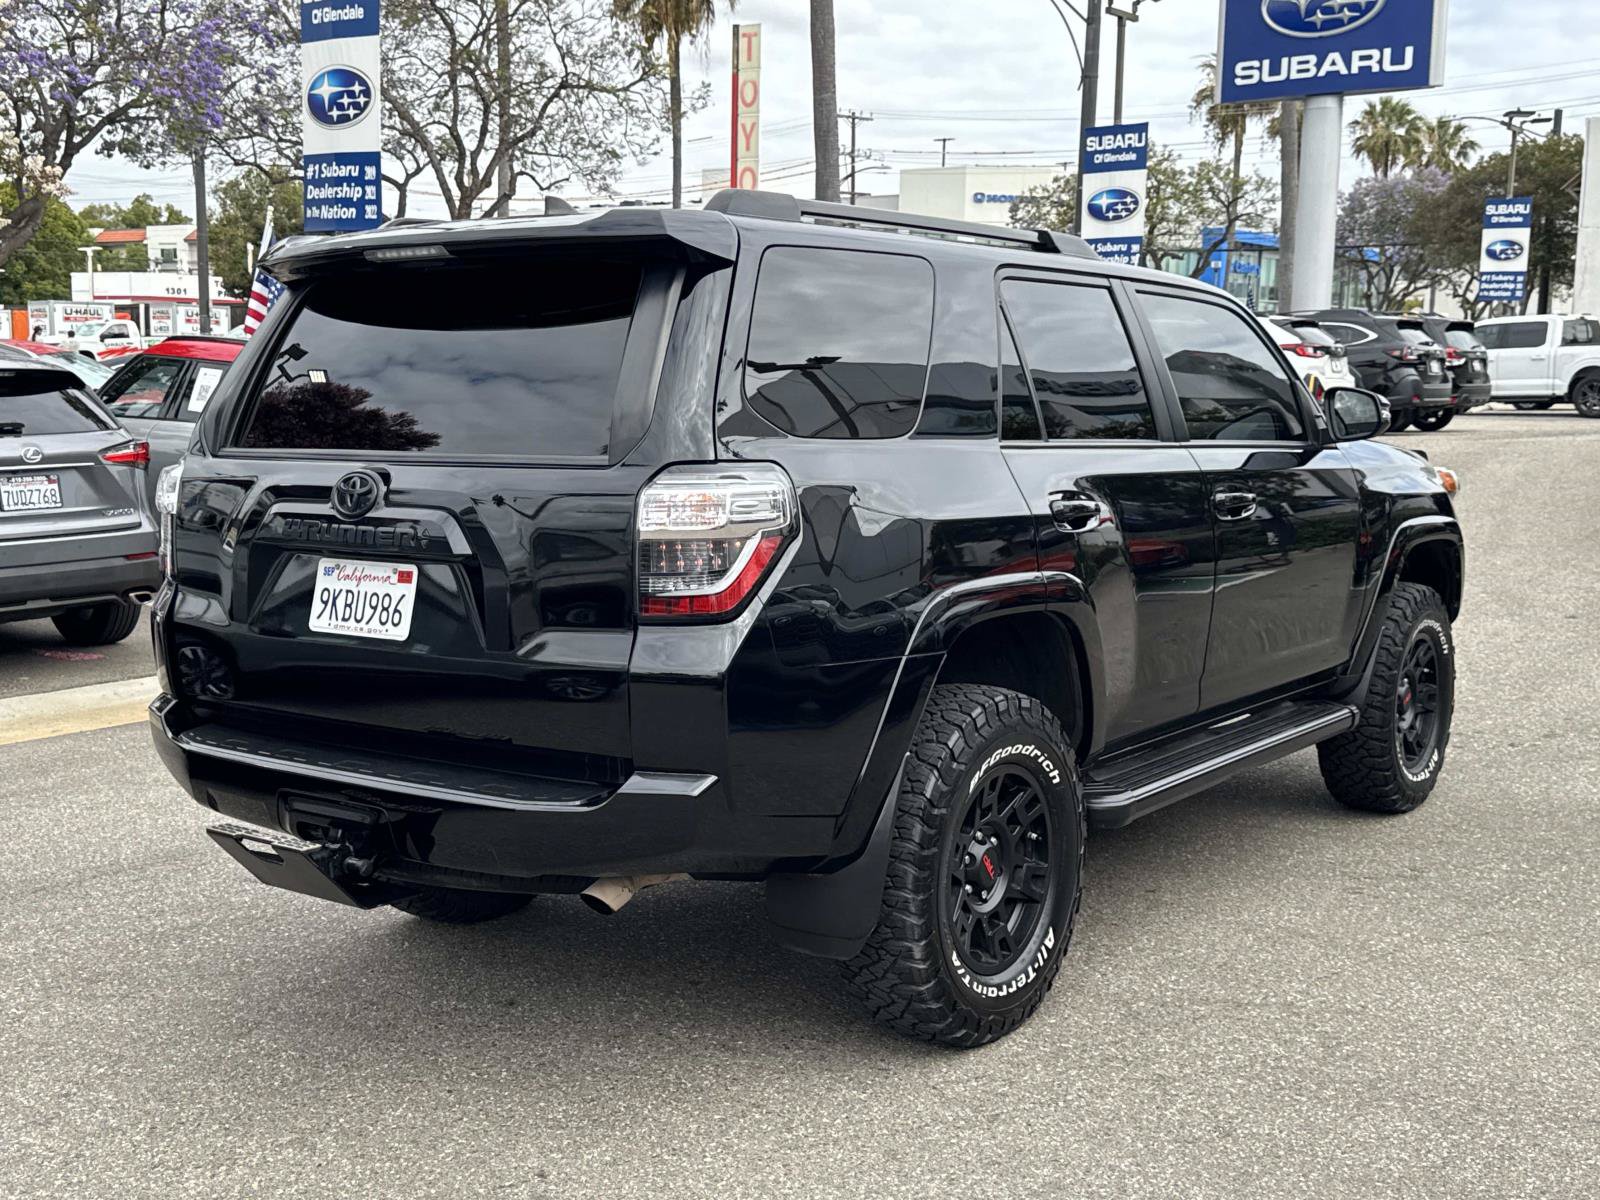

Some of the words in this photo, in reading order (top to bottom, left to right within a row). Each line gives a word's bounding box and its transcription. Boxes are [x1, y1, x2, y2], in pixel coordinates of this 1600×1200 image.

[312, 8, 322, 24] Of
[323, 4, 364, 22] Glendale
[1234, 46, 1414, 86] SUBARU
[1086, 133, 1146, 151] SUBARU
[1104, 152, 1136, 162] Glendale
[306, 164, 319, 179] #1
[320, 162, 360, 178] Subaru
[306, 182, 363, 202] Dealership
[320, 203, 357, 219] Nation
[1485, 204, 1530, 215] SUBARU
[1096, 242, 1128, 253] Subaru
[165, 287, 187, 295] 1301
[3, 489, 57, 507] 7UDZ768
[323, 566, 336, 577] SEP
[337, 565, 397, 588] California
[316, 587, 406, 627] 9KBU986
